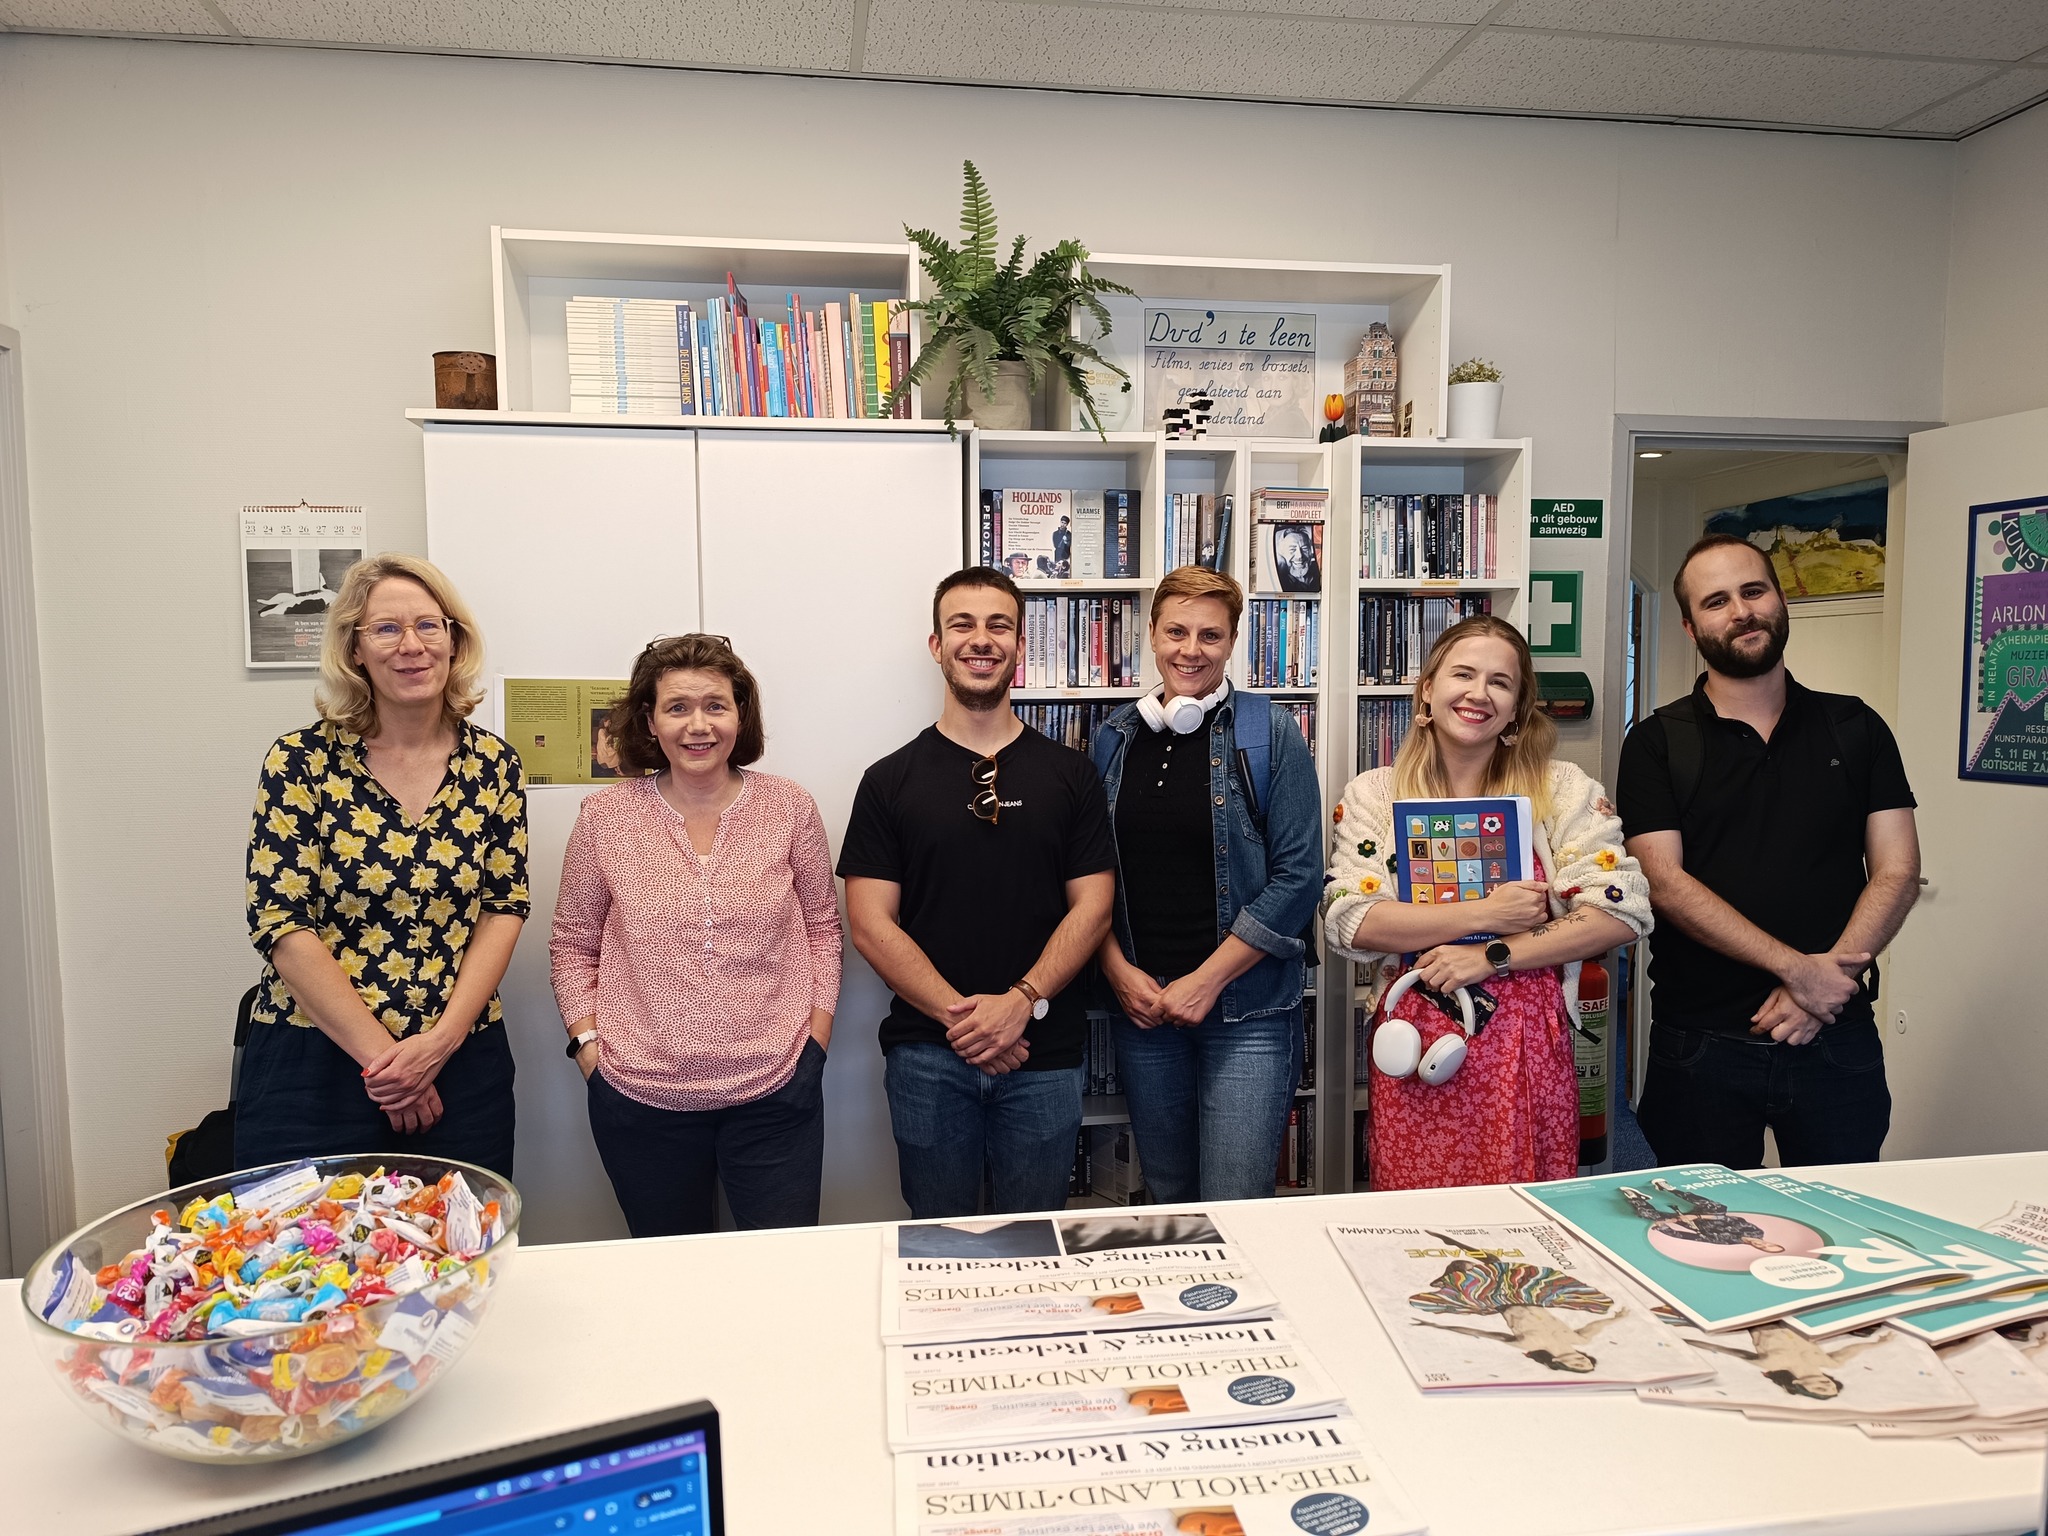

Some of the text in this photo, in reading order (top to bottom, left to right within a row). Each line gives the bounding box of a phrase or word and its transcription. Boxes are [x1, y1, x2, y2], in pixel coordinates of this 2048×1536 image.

[1149, 311, 1312, 348] Dvd's te leen
[1198, 359, 1233, 372] series
[1239, 361, 1254, 372] en
[680, 349, 691, 404] DE LEZENDE MENS
[1256, 387, 1282, 398] aan
[1012, 492, 1062, 503] HOLLANDS
[1020, 504, 1054, 515] GLORIE
[1277, 501, 1290, 509] BERT
[1552, 503, 1575, 512] AED
[1290, 510, 1321, 519] COMPLEET
[1530, 514, 1598, 525] in dit gebouw
[983, 505, 991, 559] PENOZA
[1539, 526, 1587, 536] aanwezig
[1991, 604, 2045, 623] ARLON
[1988, 691, 1995, 701] IN
[1994, 748, 2036, 760] 5, 11 EN
[1981, 759, 2028, 772] GOTISCHE
[1679, 1168, 1723, 1176] alles
[1680, 1177, 1747, 1190] Muziek
[1337, 1226, 1420, 1235] PROGRAMMA
[1503, 1225, 1554, 1235] FESTIVAL
[1403, 1248, 1525, 1259] PARADE
[907, 1249, 1226, 1275] Housing & Relocation
[1014, 1272, 1166, 1295] HOLLAND
[1175, 1271, 1243, 1285] THE
[904, 1286, 1004, 1302] TIMES
[912, 1327, 1276, 1363] Housing & Relocation
[1220, 1354, 1298, 1374] THE
[1037, 1360, 1212, 1388] HOLLAND
[912, 1374, 1025, 1397] TIMES
[1061, 1398, 1093, 1406] make
[926, 1428, 1342, 1472] Housing & Relocation
[925, 1463, 1370, 1515] THE HOLLAND TIMES
[1296, 1494, 1345, 1515] community
[1098, 1523, 1134, 1532] make
